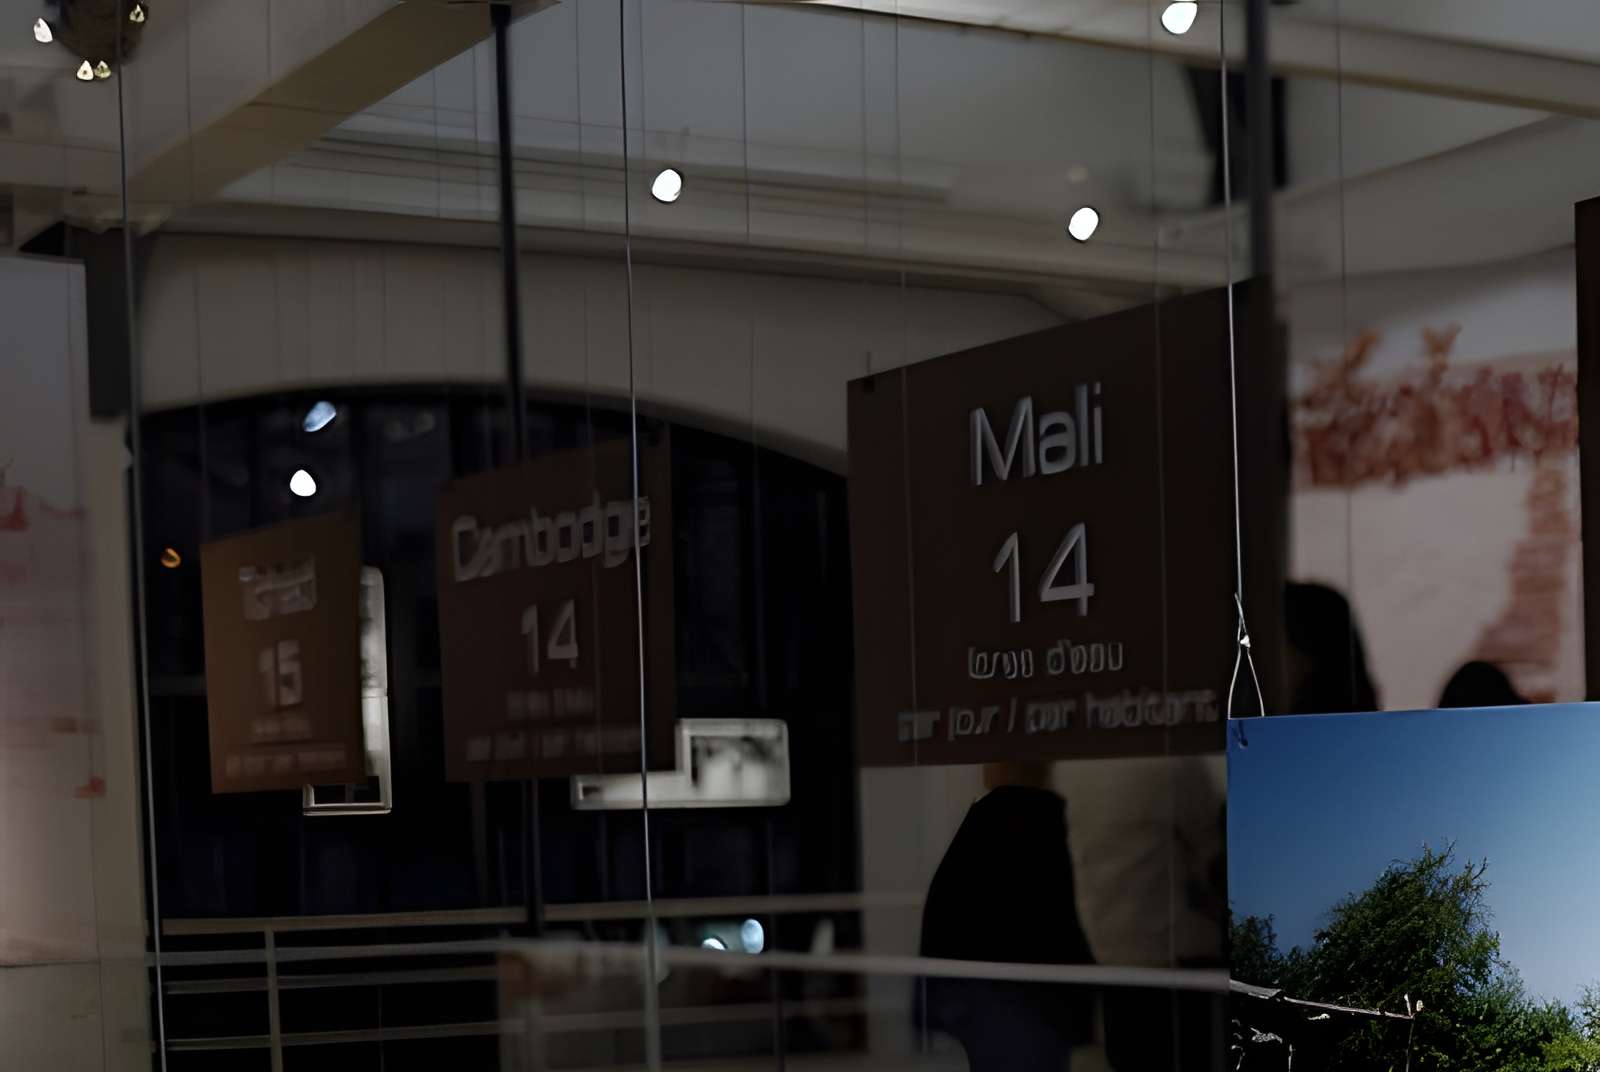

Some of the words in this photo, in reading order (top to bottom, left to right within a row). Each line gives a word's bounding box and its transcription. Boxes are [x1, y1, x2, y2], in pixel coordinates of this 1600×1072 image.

[970, 382, 1103, 486] Mali
[993, 522, 1095, 623] 14
[520, 600, 579, 676] 14
